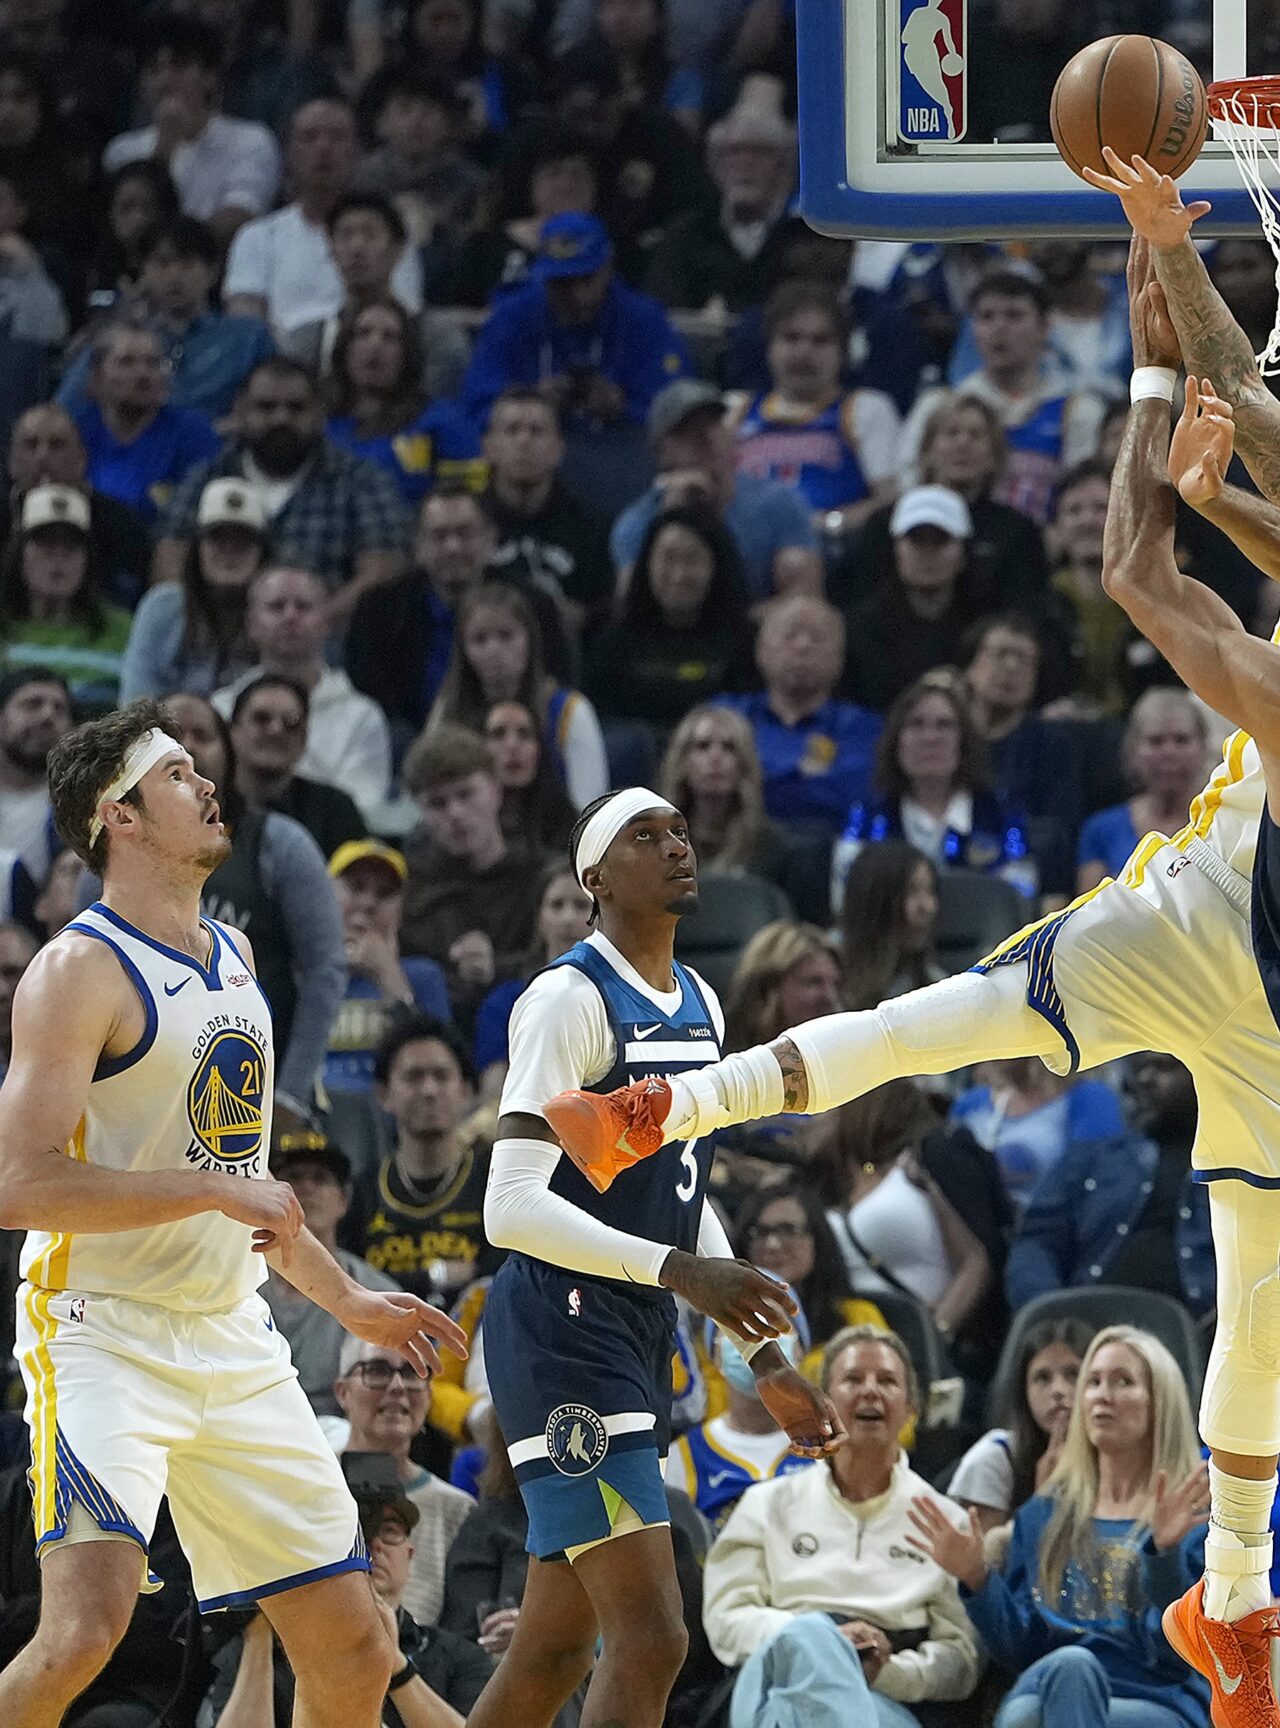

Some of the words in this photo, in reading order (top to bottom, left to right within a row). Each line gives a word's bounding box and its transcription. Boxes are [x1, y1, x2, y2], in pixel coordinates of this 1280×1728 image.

[907, 107, 940, 133] NBA
[1159, 61, 1195, 156] Wilson
[192, 1014, 231, 1060] GOLDEN
[234, 1015, 269, 1051] STATE
[239, 1059, 260, 1096] 21
[675, 1138, 699, 1203] 3
[565, 1407, 605, 1457] TIMBERWOLVES
